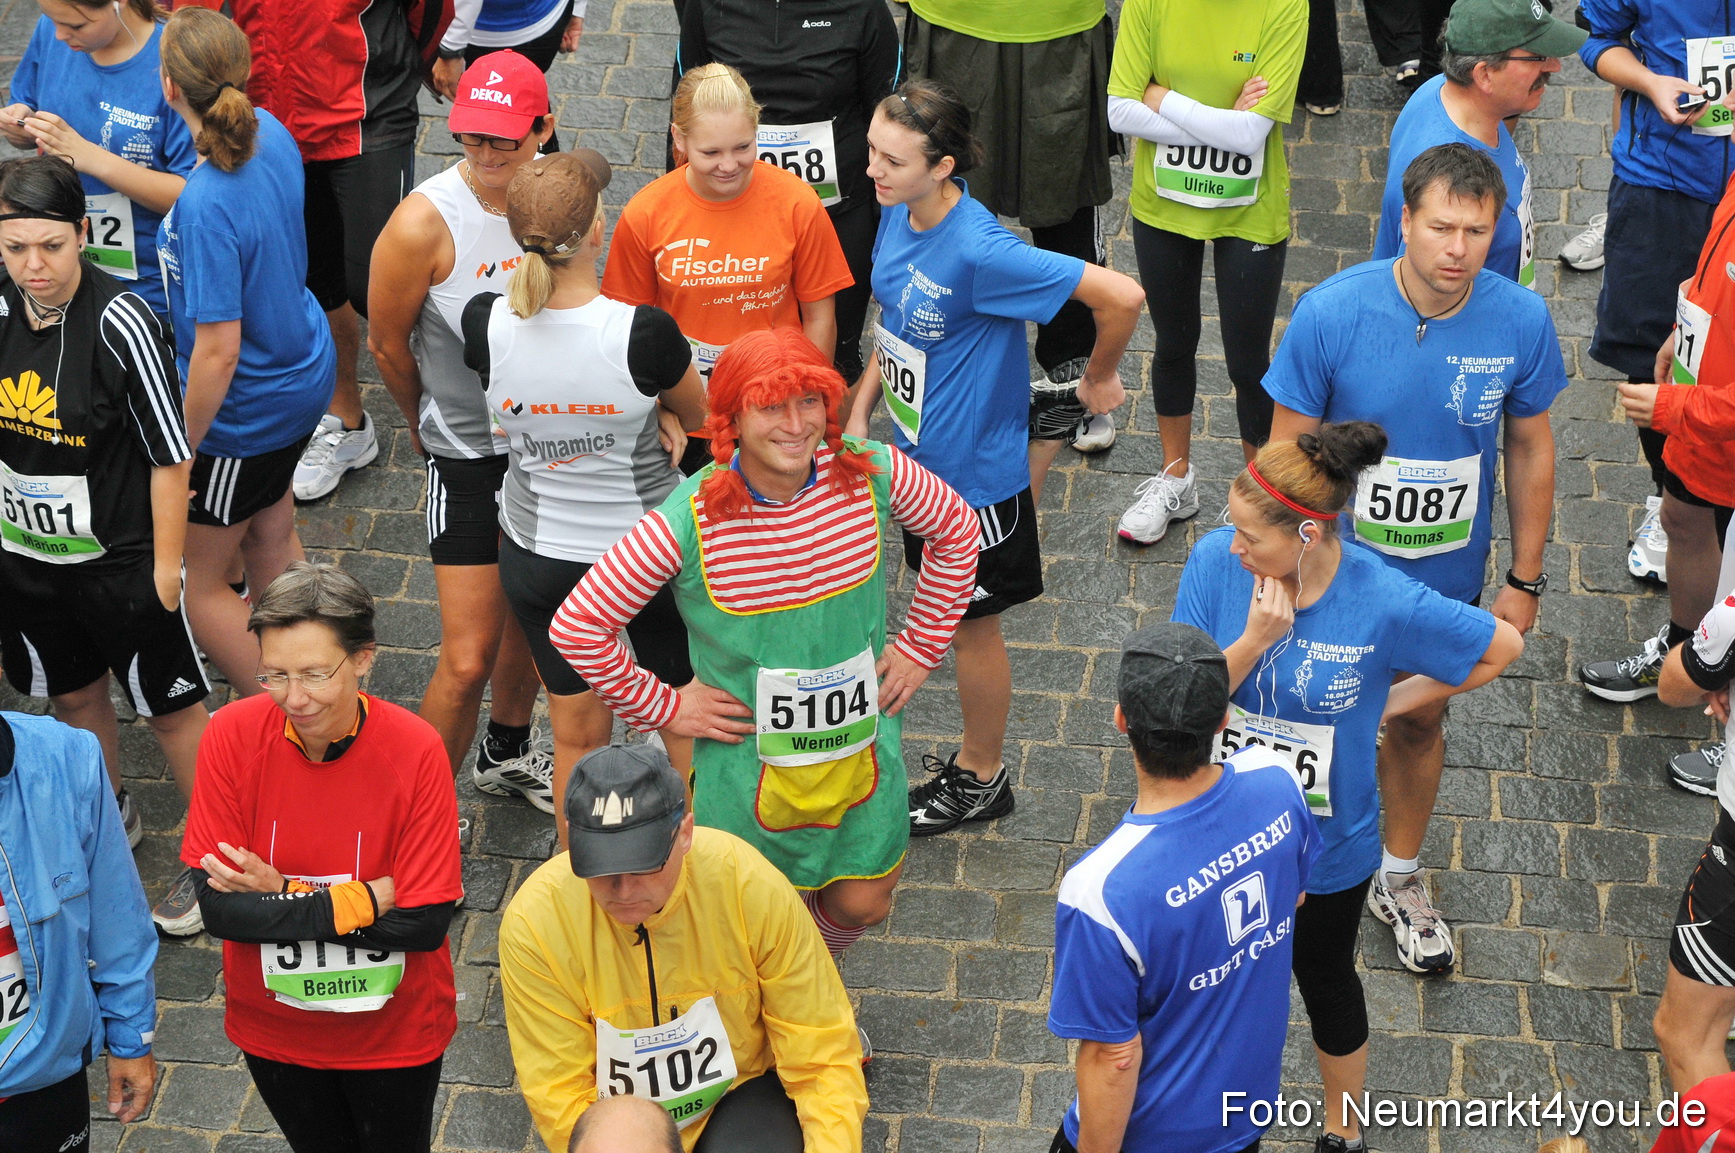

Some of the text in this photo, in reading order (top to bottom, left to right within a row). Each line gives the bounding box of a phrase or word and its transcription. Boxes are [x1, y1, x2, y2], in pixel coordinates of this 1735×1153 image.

[469, 87, 512, 107] DEKRA
[107, 114, 153, 131] STADTLAUF
[757, 131, 799, 141] BOCK
[1184, 176, 1225, 196] Ulrike
[671, 253, 770, 277] Fischer
[680, 274, 763, 287] AUTOMOBILE
[906, 263, 953, 296] 12. NEUMARKTER
[911, 275, 941, 300] STADTLAUF
[736, 285, 757, 300] das
[1446, 355, 1515, 366] 12. NEUMARKTER
[1459, 365, 1505, 374] STADTLAUF
[530, 403, 625, 415] KLEBL
[521, 431, 617, 461] Dynamics
[1398, 466, 1448, 478] BOCK
[2, 484, 79, 536] 5101
[1369, 482, 1469, 523] 5087
[21, 533, 69, 553] Marina
[1384, 528, 1445, 545] Thomas
[1296, 638, 1375, 655] 12. NEUMARKTER
[1306, 650, 1362, 664] STADTLAUF
[797, 668, 846, 686] BOCK
[167, 682, 197, 698] adidas
[770, 679, 870, 730] 5104
[791, 732, 851, 751] Werner
[1164, 810, 1291, 908] GANSBRÄU
[303, 975, 369, 997] Beatrix
[634, 1022, 687, 1048] BOCK
[608, 1036, 723, 1098] 5102
